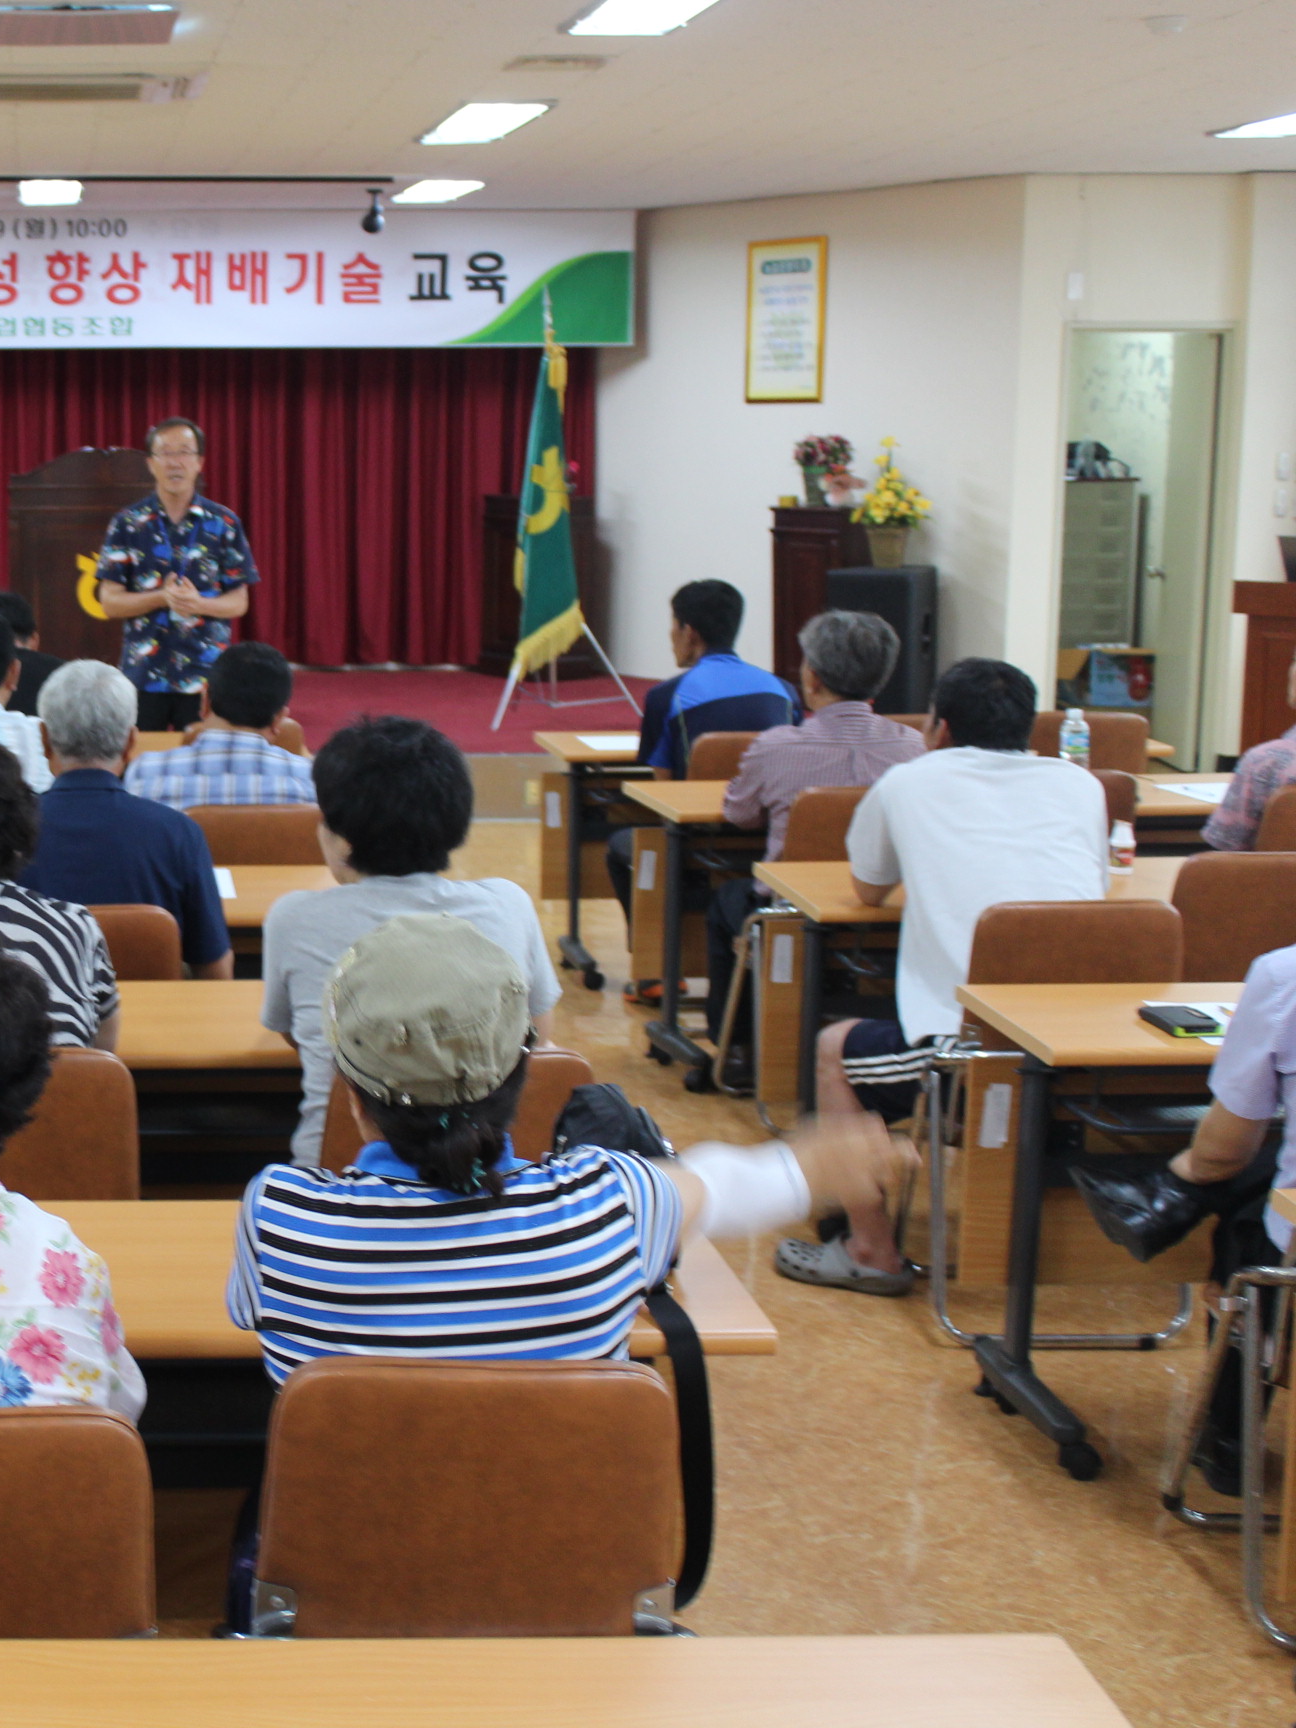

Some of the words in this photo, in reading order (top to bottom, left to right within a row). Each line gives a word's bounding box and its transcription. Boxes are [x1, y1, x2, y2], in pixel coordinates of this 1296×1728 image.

[66, 218, 128, 239] 10:00
[45, 249, 148, 305] 향상
[171, 250, 384, 305] 재배기술
[408, 250, 509, 304] 교육
